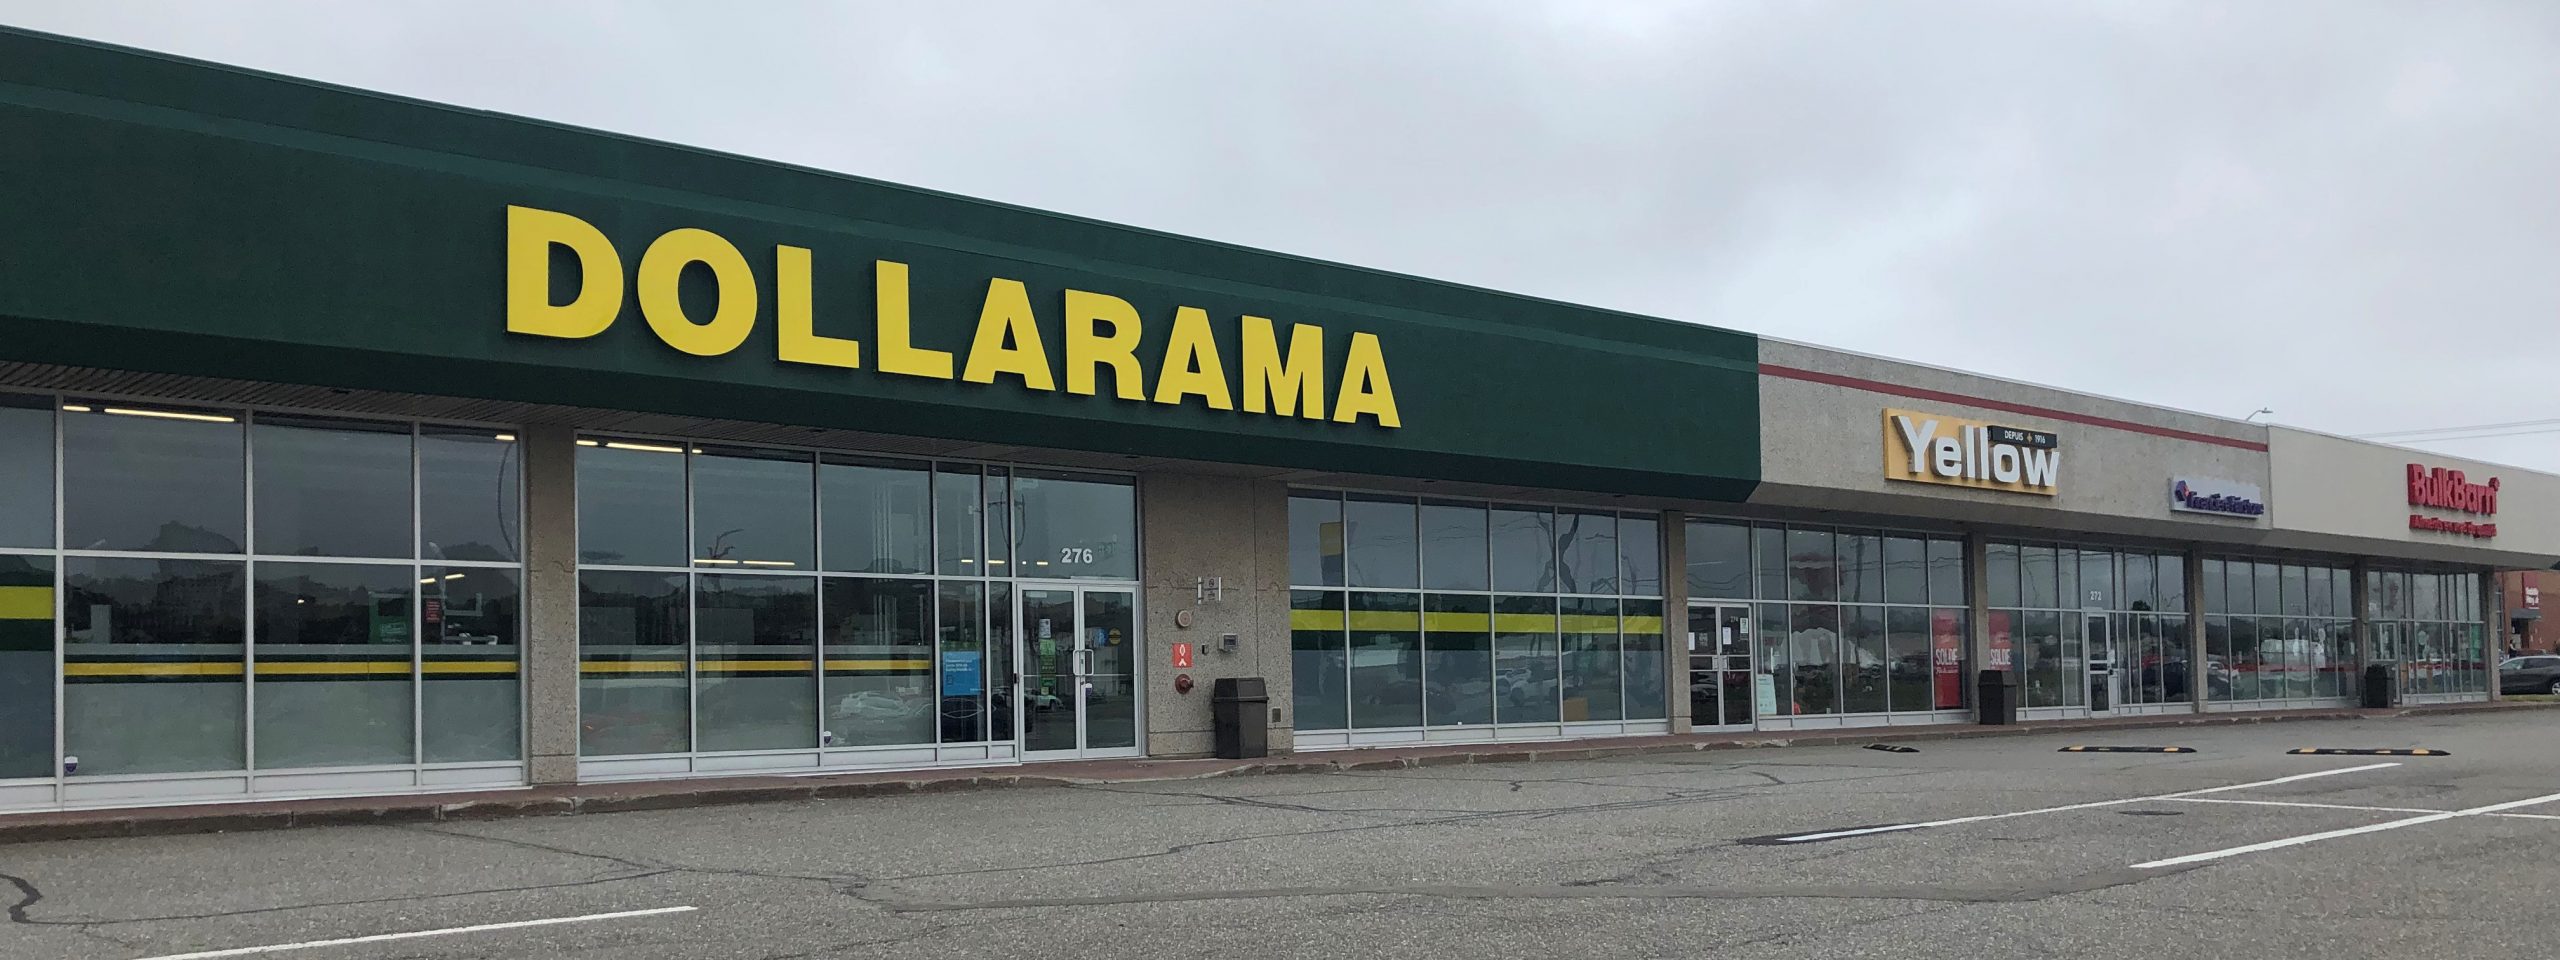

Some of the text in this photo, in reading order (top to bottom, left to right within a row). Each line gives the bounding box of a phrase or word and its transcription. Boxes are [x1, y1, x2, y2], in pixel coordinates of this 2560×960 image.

[506, 205, 1402, 430] DOLLARAMA
[2004, 430, 2046, 444] DEPUIS 1916
[1889, 415, 2061, 487] Yellow
[1061, 547, 1093, 564] 276
[2090, 590, 2102, 601] 272
[1935, 648, 1958, 666] SOLDE
[1990, 648, 2011, 666] SOLDE
